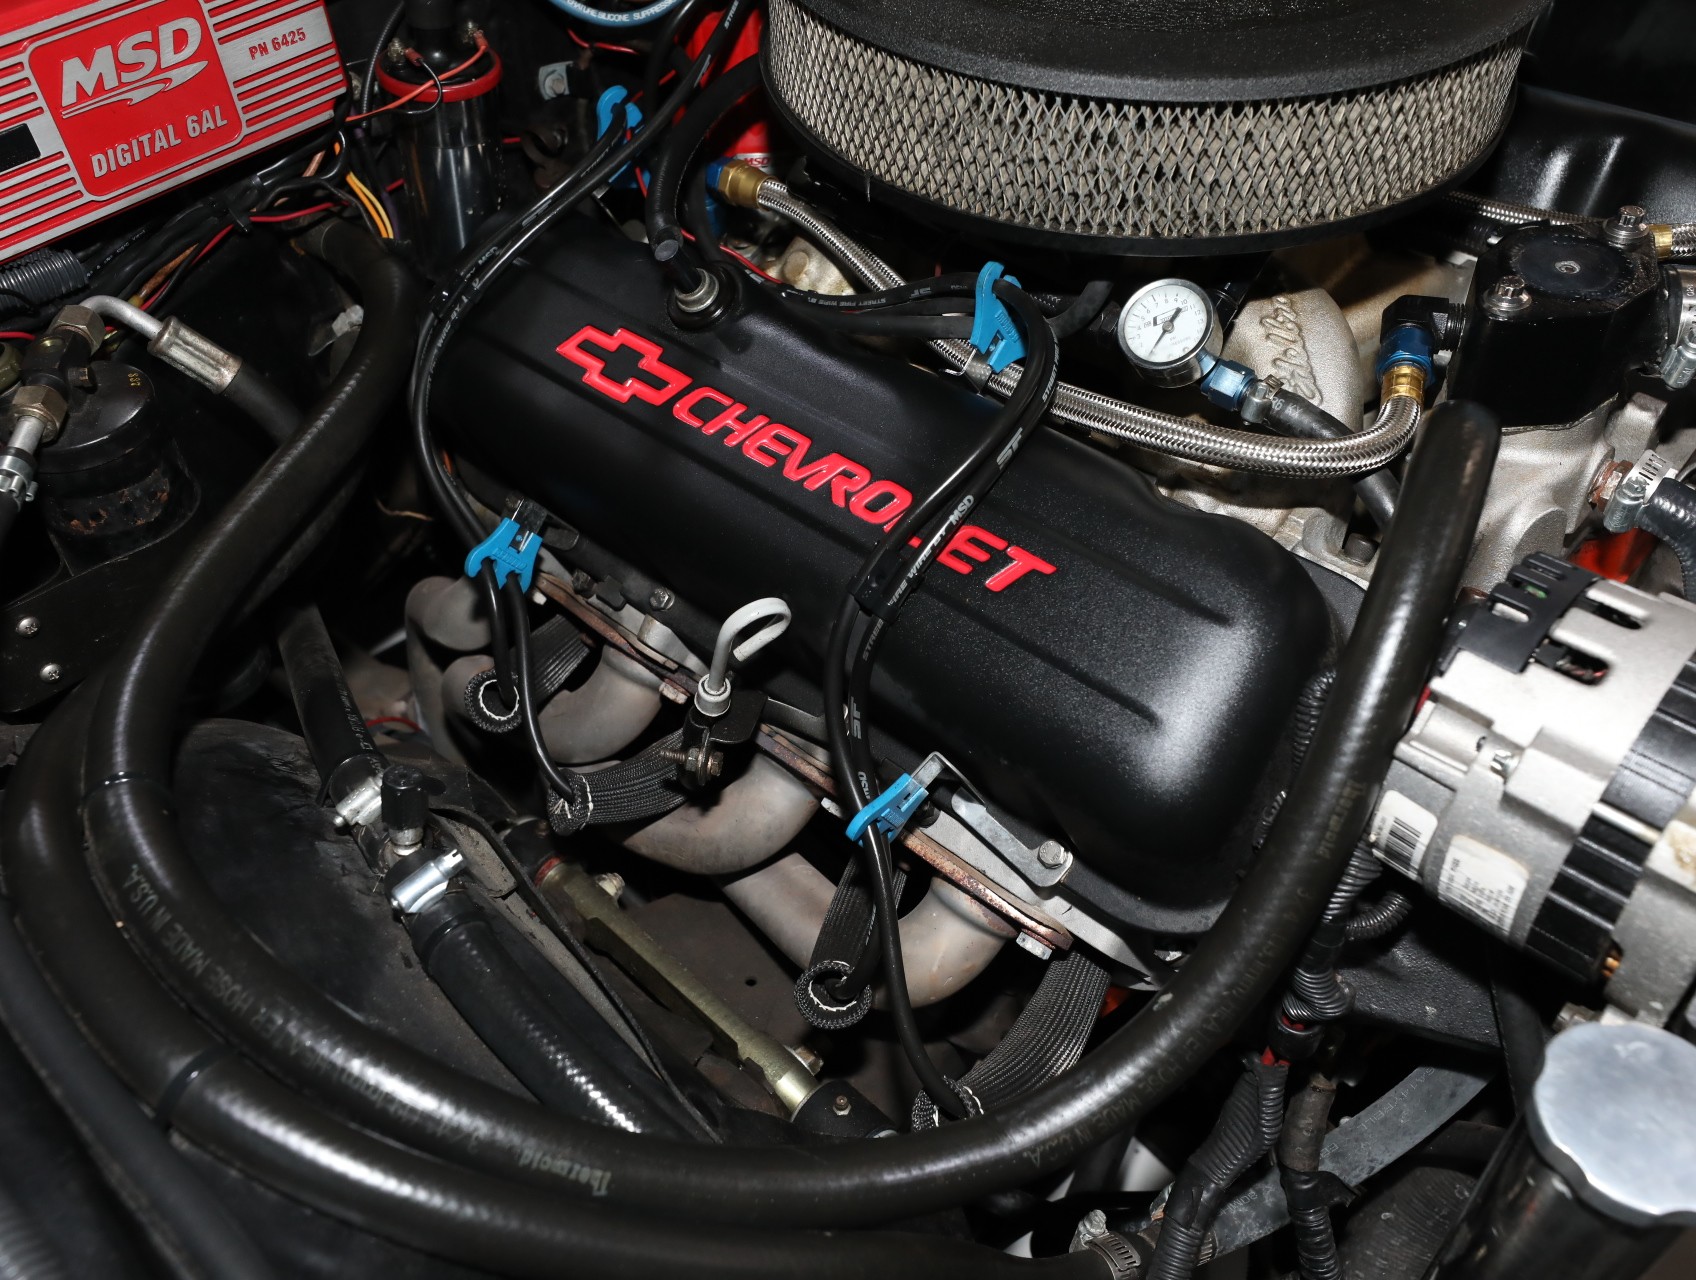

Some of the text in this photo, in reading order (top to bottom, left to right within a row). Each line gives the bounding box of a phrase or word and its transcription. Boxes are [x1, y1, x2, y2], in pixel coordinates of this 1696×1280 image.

[62, 17, 202, 107] MSD
[249, 27, 307, 60] PN 6425
[91, 105, 228, 178] DIGITAL 6AL
[672, 386, 1058, 594] CHEVROET
[948, 495, 975, 526] MSD
[161, 921, 212, 978] MADE
[208, 965, 256, 1018] HOSE
